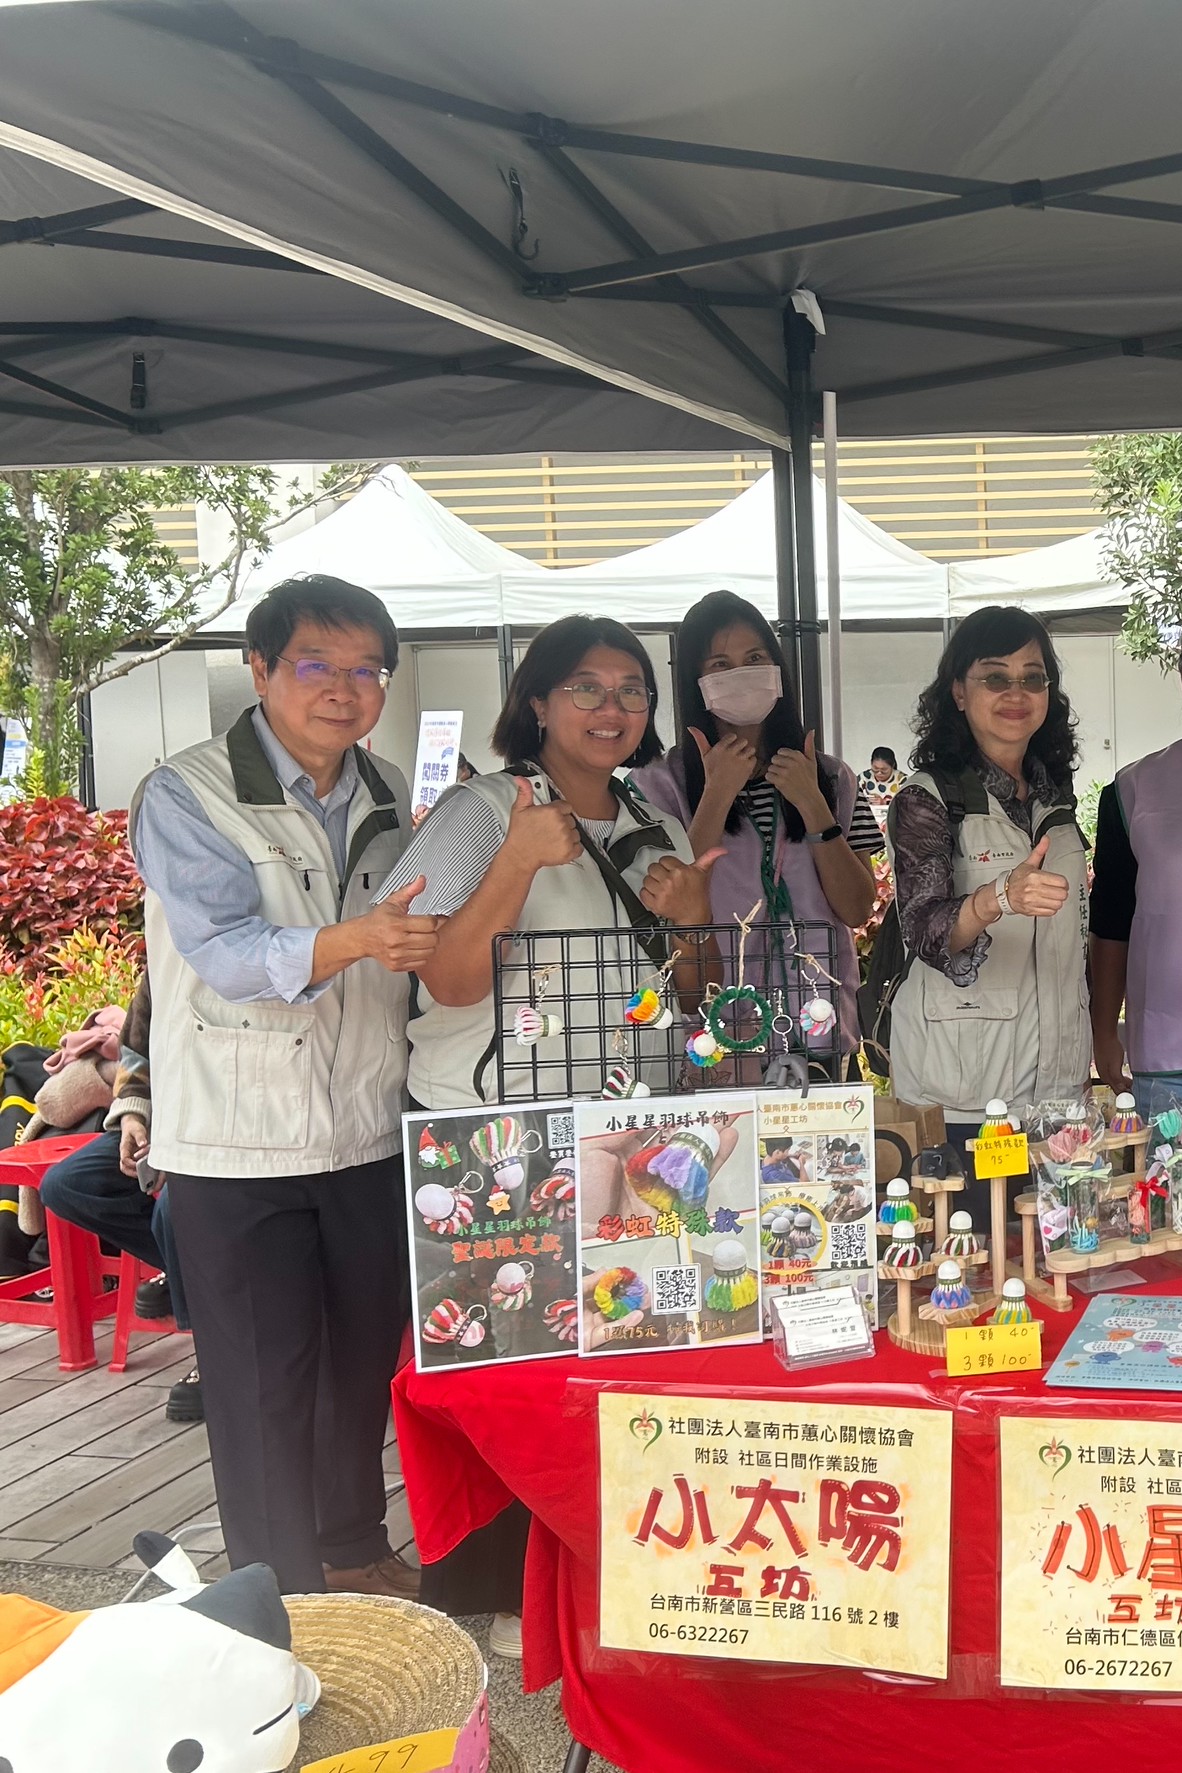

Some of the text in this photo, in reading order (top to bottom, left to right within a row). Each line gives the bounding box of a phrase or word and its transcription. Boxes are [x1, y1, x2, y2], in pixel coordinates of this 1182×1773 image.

[606, 1110, 729, 1132] 小星星羽球吊飾
[764, 1115, 808, 1126] 小星星工坊
[457, 1216, 551, 1237] 小星星羽球吊飾
[596, 1207, 744, 1242] 彩虹特殊款
[452, 1233, 563, 1264] 聖誕限定款
[789, 1258, 812, 1268] 40元
[785, 1273, 814, 1283] 100元
[668, 1416, 915, 1448] 社團法人臺南市蕙心關懷協會
[695, 1447, 878, 1474] 附設 社區日間作業設施
[1101, 1476, 1137, 1494] 附設
[636, 1474, 904, 1573] 小太陽
[650, 1593, 900, 1629] 台南市新營區三民路 116 號 2 樓
[648, 1623, 749, 1645] 06-6322267
[1064, 1658, 1173, 1679] 06-2672267
